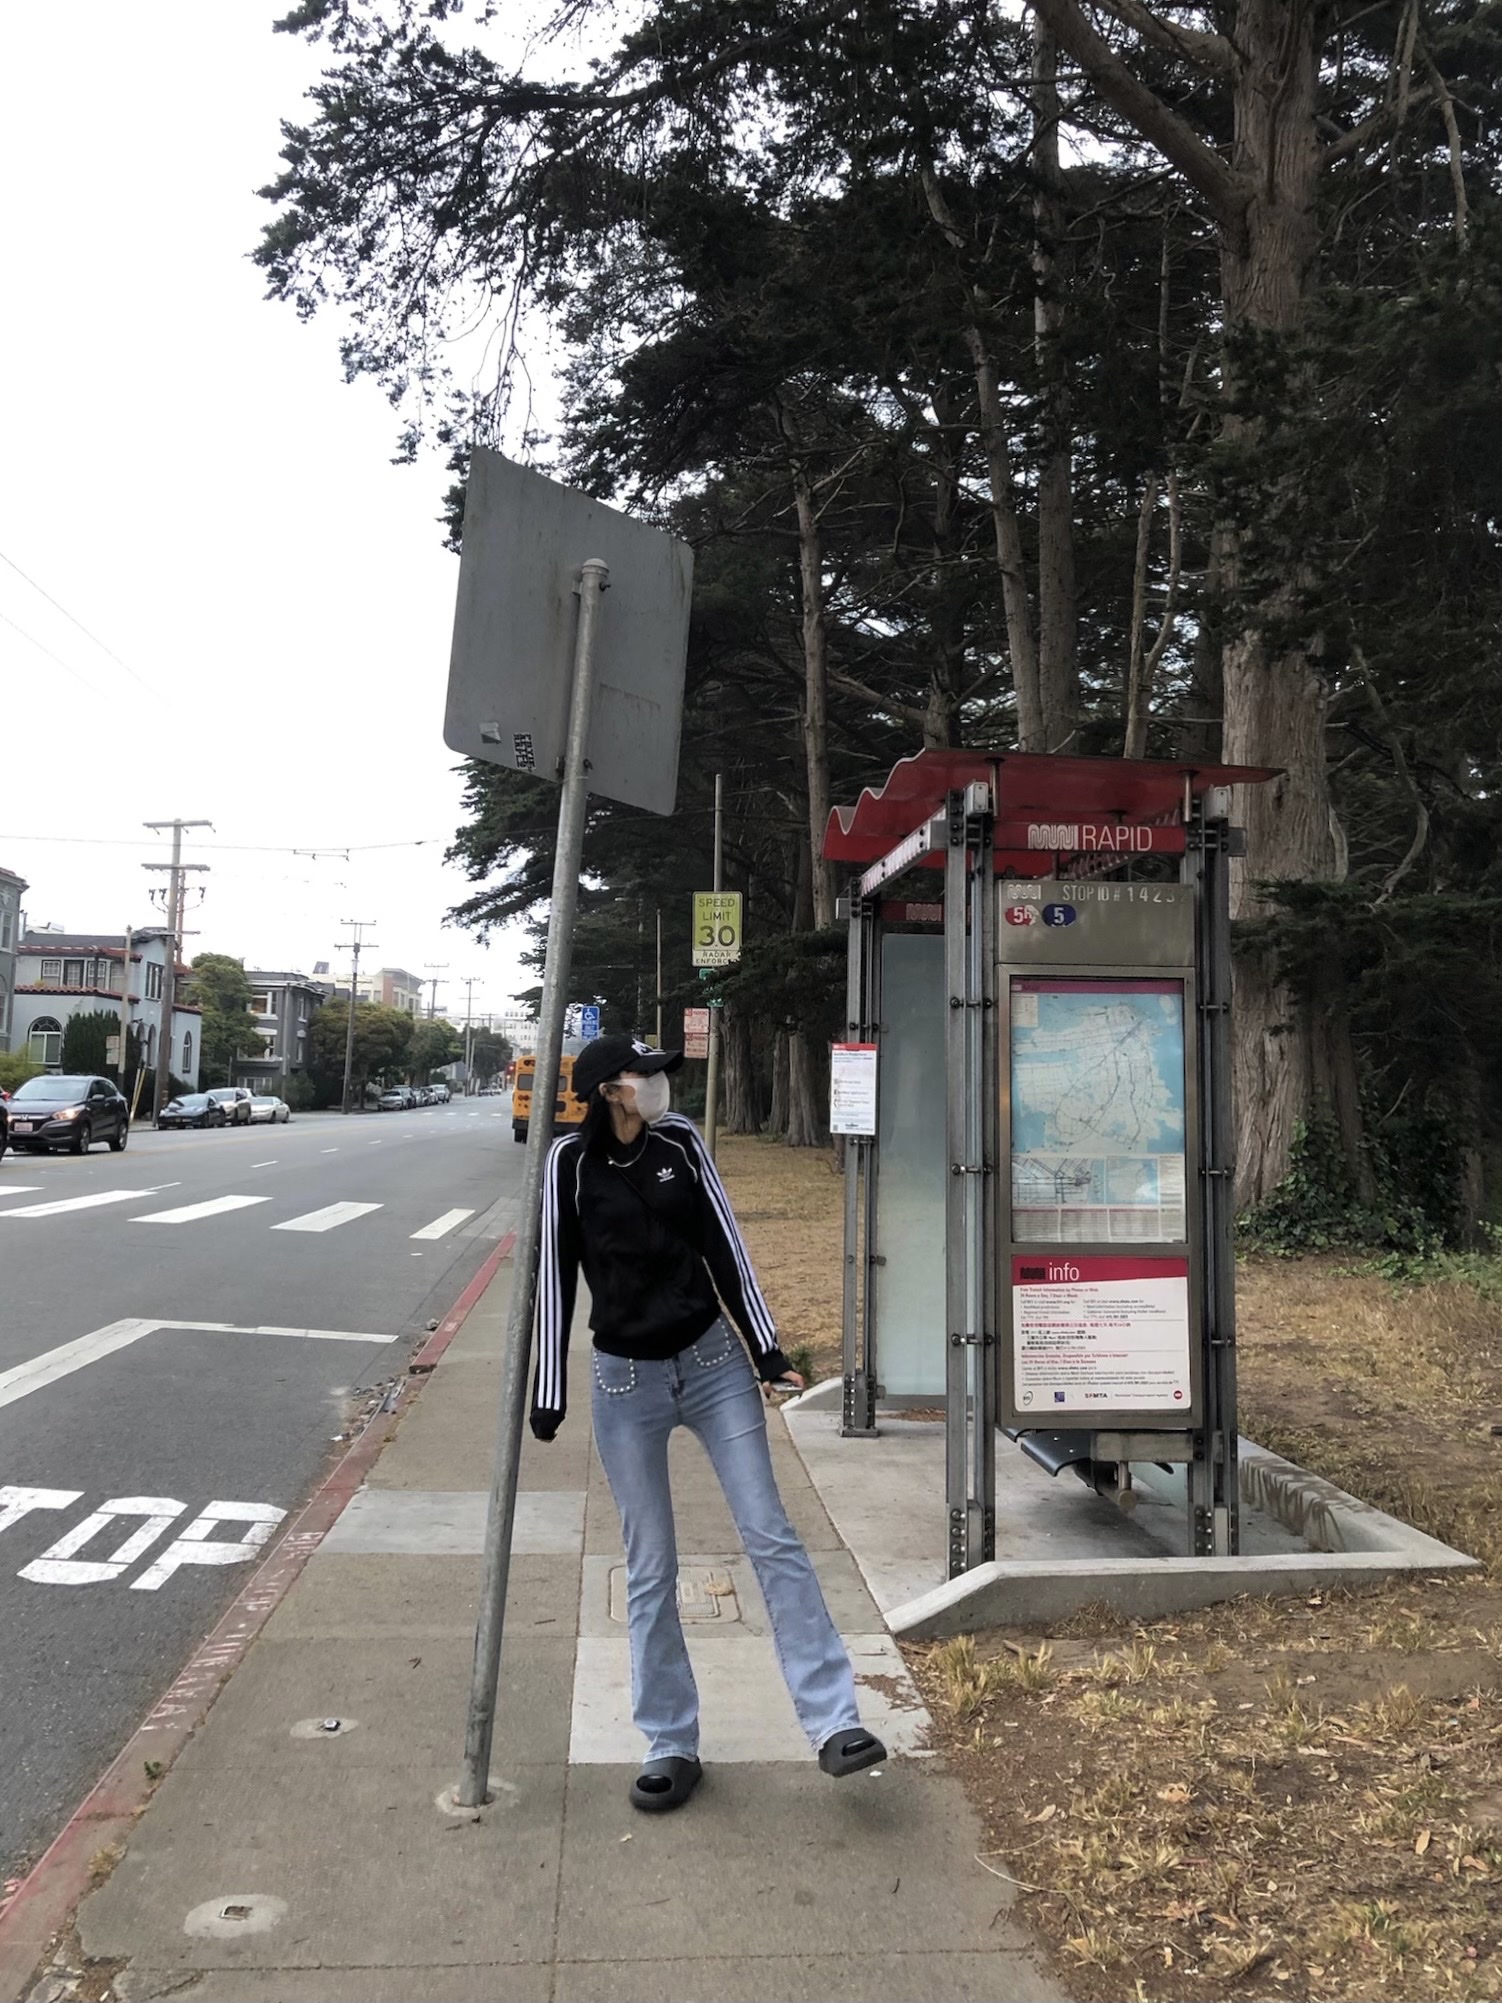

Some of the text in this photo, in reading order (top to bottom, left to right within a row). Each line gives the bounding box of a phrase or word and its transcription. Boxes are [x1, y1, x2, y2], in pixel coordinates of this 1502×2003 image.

[1082, 826, 1153, 852] RAPID
[1062, 884, 1094, 901] STOP
[1097, 884, 1109, 901] ID
[698, 898, 735, 907] SPEED
[702, 911, 731, 921] LIMIT
[1053, 906, 1065, 924] 5
[698, 925, 735, 947] 30
[1049, 1262, 1080, 1281] info
